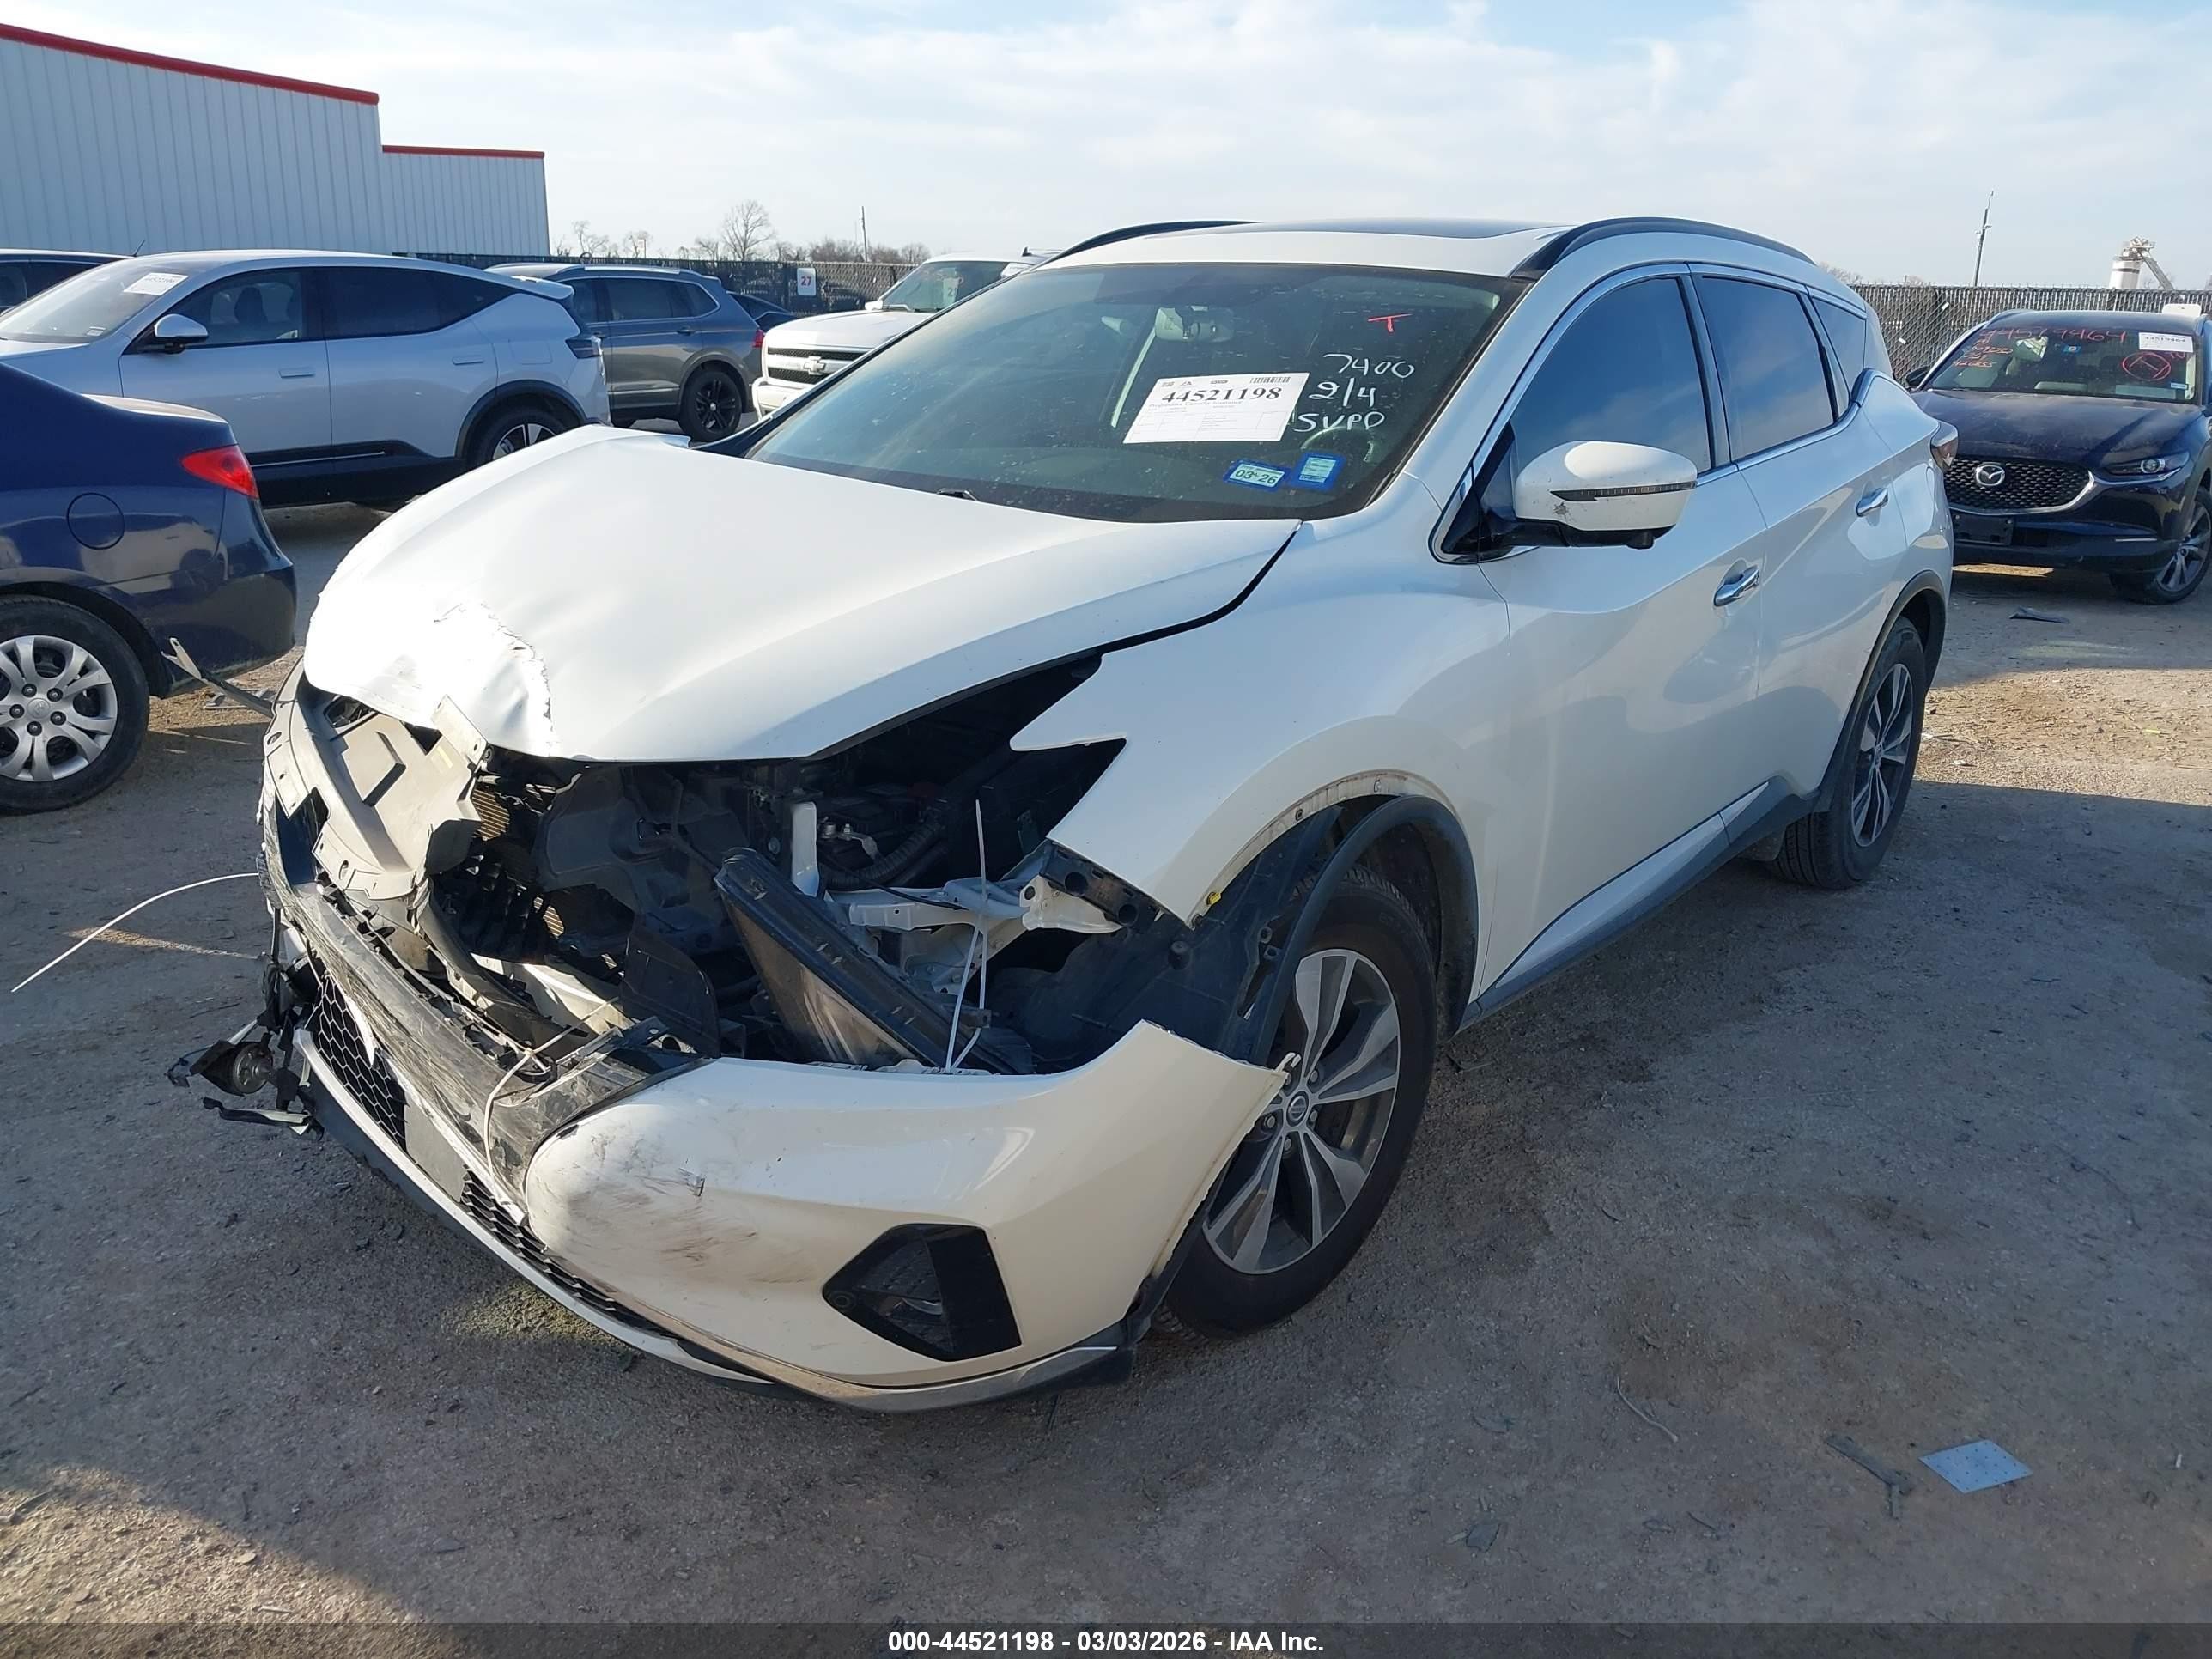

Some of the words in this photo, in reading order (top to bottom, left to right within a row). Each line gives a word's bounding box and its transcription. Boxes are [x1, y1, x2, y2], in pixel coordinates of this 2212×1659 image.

[800, 276, 812, 286] 27
[1367, 313, 1413, 333] T
[1322, 353, 1415, 379] 7400
[1161, 386, 1283, 402] 44521198
[1308, 377, 1377, 408] 2/4
[1258, 473, 1279, 485] 26
